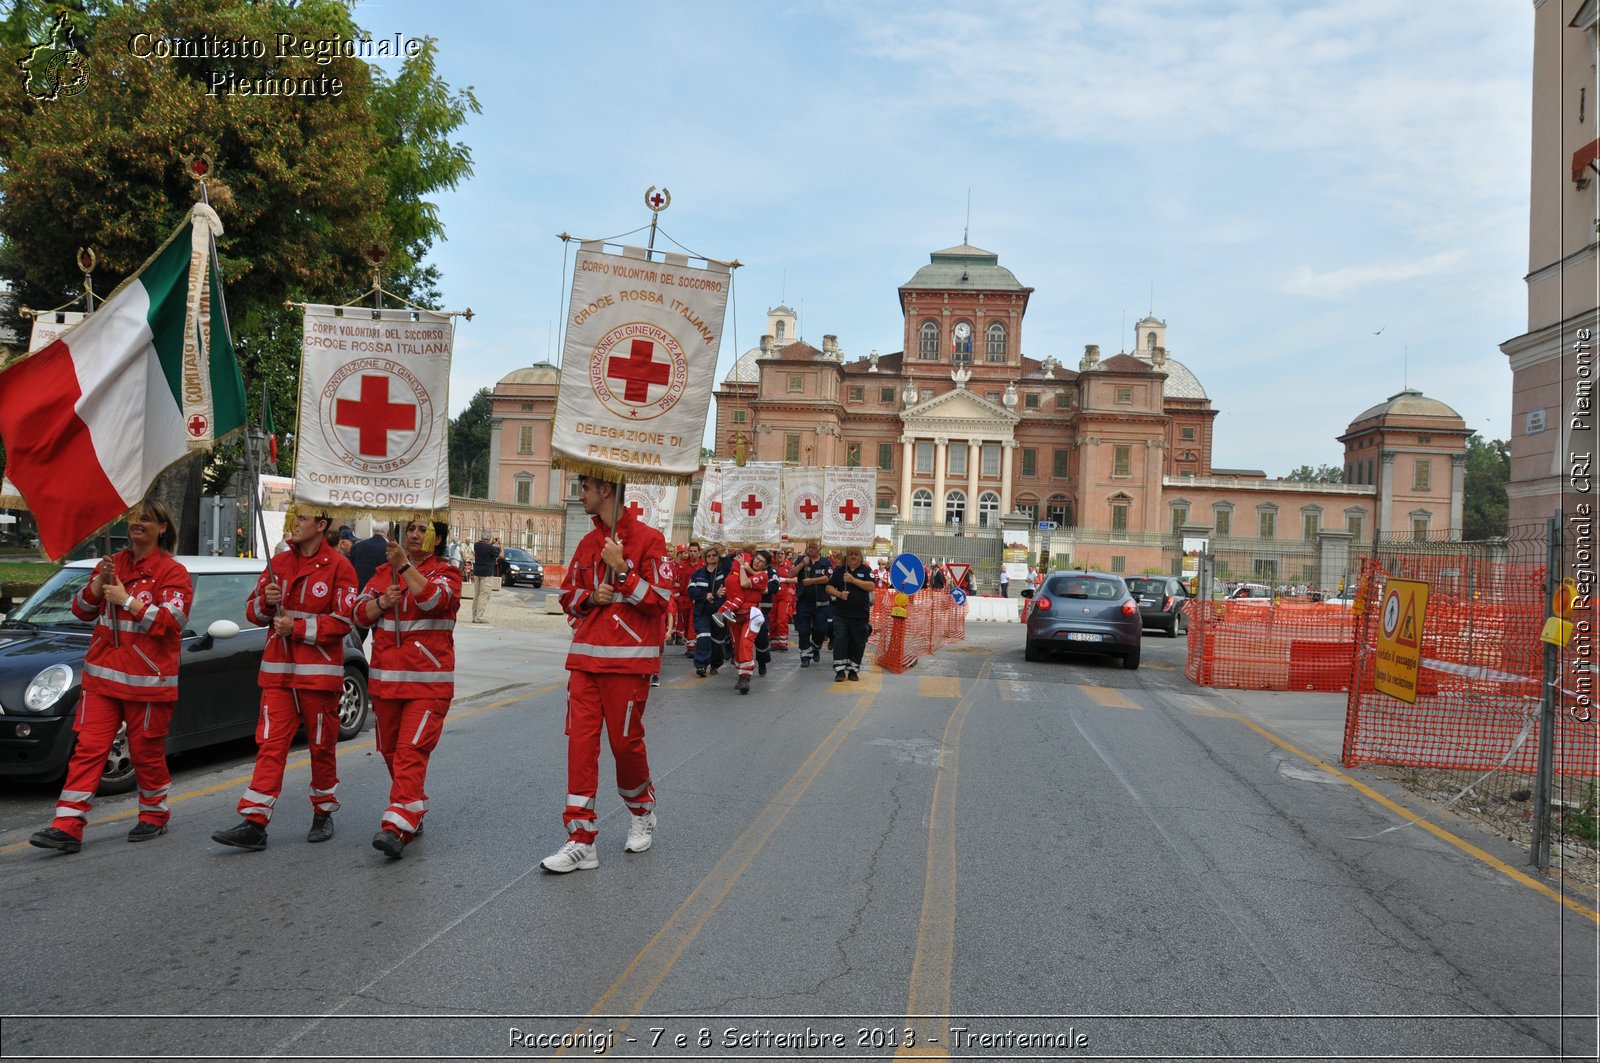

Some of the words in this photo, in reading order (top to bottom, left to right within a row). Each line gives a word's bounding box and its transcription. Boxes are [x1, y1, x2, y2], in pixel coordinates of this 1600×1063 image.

[582, 260, 610, 275] CORPO
[612, 265, 658, 283] VOLONTARI
[660, 273, 676, 286] DEL
[678, 276, 722, 293] SOCCORSO
[574, 294, 616, 326] CROCE
[619, 290, 664, 305] ROSSA
[670, 298, 714, 346] ITALIANA
[339, 325, 380, 339] VOLONTARI
[385, 329, 401, 340] DEL
[613, 329, 624, 340] DI
[625, 325, 667, 343] GINEVRA
[305, 335, 347, 351] CROCE
[351, 341, 393, 353] ROSSA
[397, 342, 450, 356] ITALIANA
[666, 339, 678, 352] 22
[184, 343, 204, 404] COMITATO
[592, 335, 615, 402] CONVENZIONE
[673, 352, 686, 393] AGOSTO
[324, 360, 380, 399] CONVENZIONE
[384, 361, 395, 371] DI
[397, 369, 429, 406] GINEVRA
[658, 393, 677, 410] 1864
[575, 421, 665, 446] DELEGAZIONE
[669, 436, 683, 448] DI
[587, 443, 663, 466] PAESANA
[309, 472, 370, 486] COMITATO
[374, 477, 421, 489] LOCALE
[424, 478, 434, 489] DI
[328, 489, 420, 505] RACCONIGI
